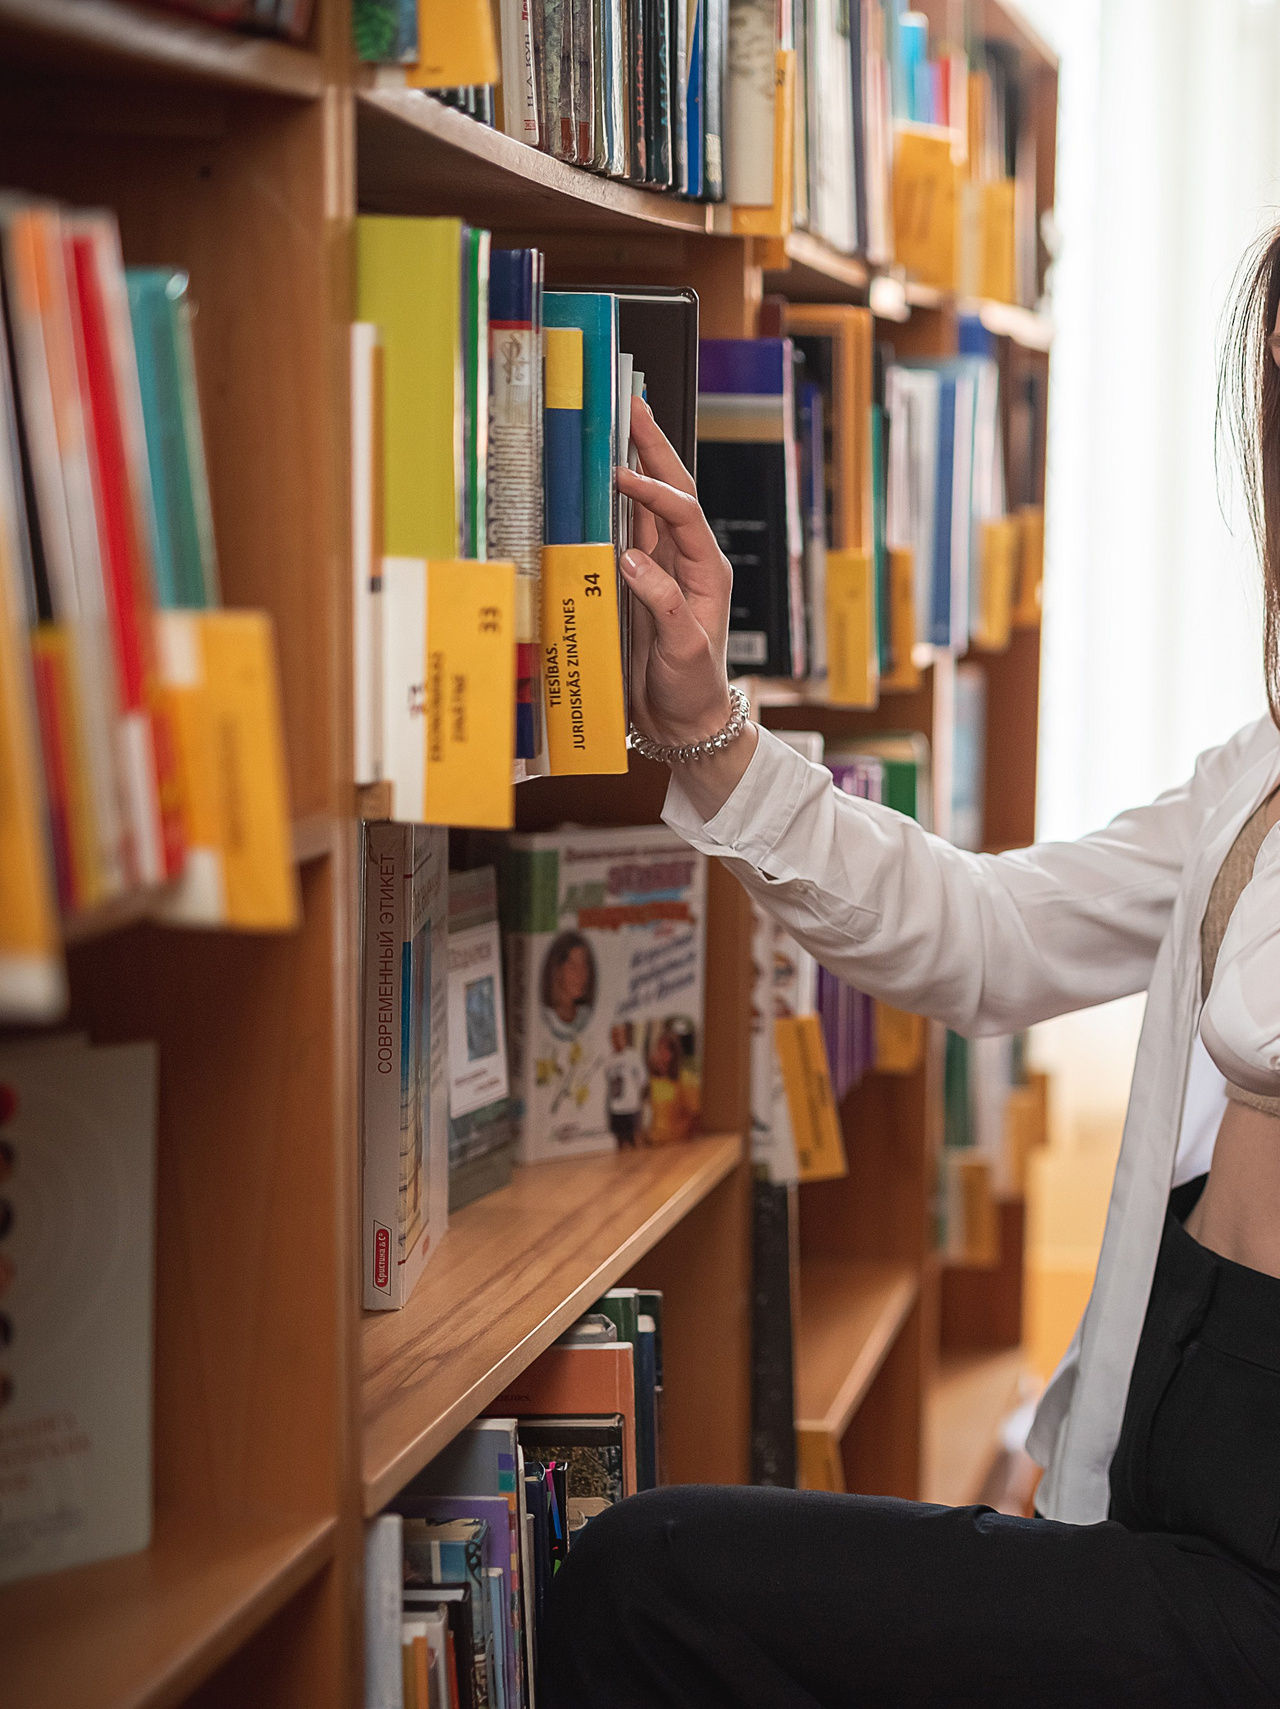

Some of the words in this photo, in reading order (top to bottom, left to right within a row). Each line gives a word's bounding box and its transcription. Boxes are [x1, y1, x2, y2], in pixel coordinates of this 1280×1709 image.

[584, 572, 602, 597] 34
[478, 605, 501, 634] 33
[562, 598, 580, 667] ZINĀTNES
[545, 643, 562, 708] TIESĪBAS.
[566, 670, 586, 750] JURIDISKĀS
[379, 853, 395, 925] ЭТИКЕТ
[376, 930, 393, 1074] СОВРЕМЕННЫЙ
[377, 1248, 387, 1283] Кристина
